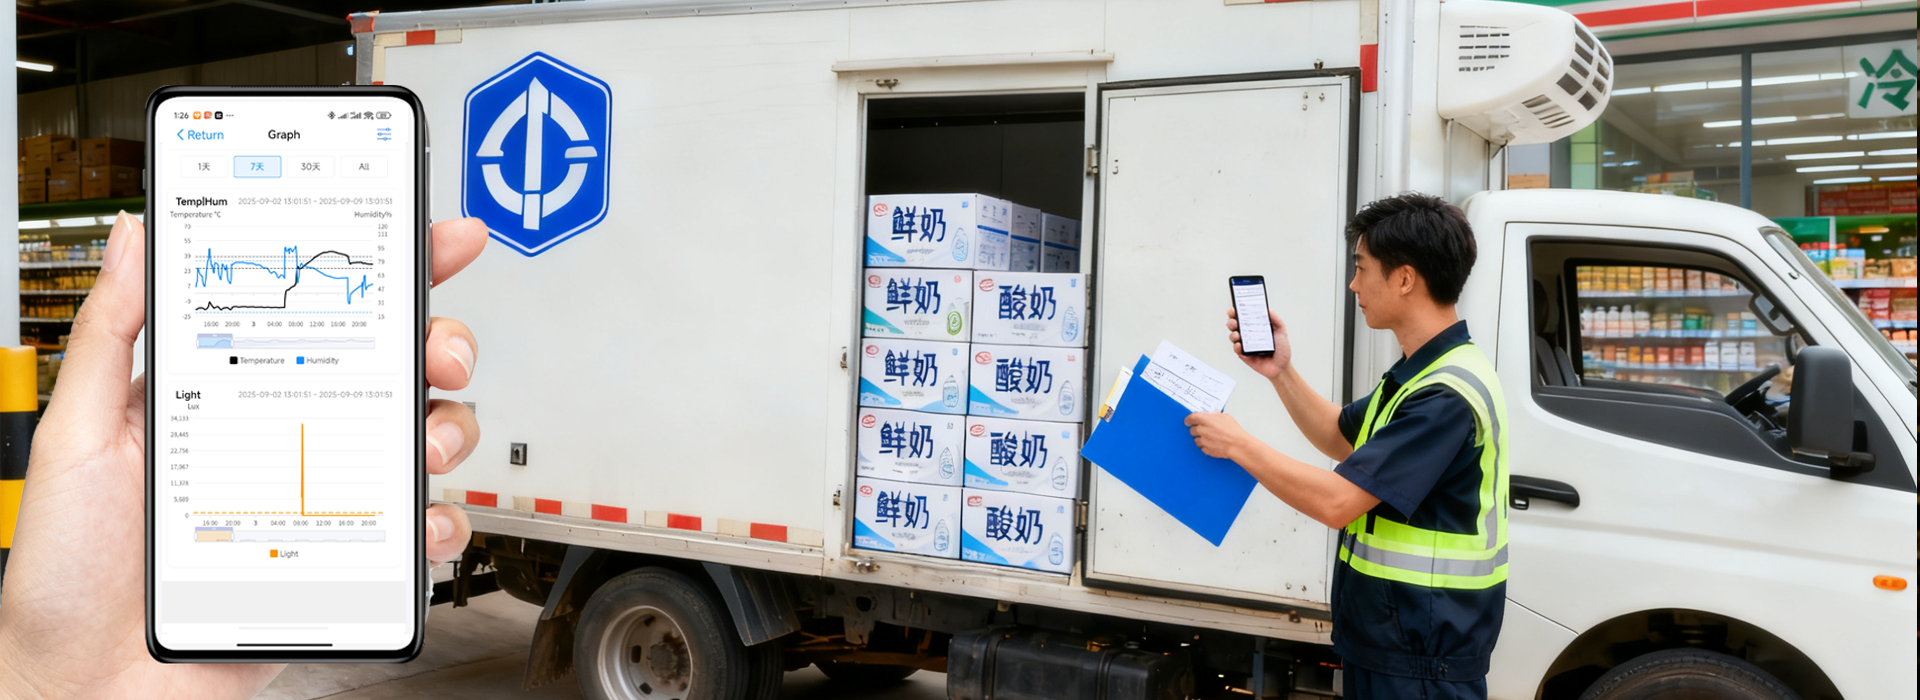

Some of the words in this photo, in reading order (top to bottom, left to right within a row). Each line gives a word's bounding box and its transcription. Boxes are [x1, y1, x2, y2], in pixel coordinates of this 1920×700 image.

[1858, 51, 1917, 110] 冷
[173, 111, 190, 120] 1:26
[188, 130, 224, 140] Return
[268, 129, 300, 142] Graph
[197, 162, 211, 172] 1天
[251, 162, 264, 171] 7天
[300, 162, 321, 172] 30天
[358, 162, 370, 171] All
[176, 196, 227, 208] Temp|Hum
[237, 197, 282, 205] 2025-09-02
[283, 197, 312, 205] 13:01:51
[318, 197, 364, 205] 2025-09-09
[365, 197, 393, 205] 13:01:51
[169, 210, 214, 220] Temperature
[353, 210, 393, 220] Humidity%
[892, 206, 946, 242] 鲜奶
[887, 278, 940, 314] 鲜奶
[999, 285, 1056, 320] 酸奶
[203, 320, 220, 328] 16:00
[224, 320, 241, 328] 20:00
[266, 320, 283, 328] 04:00
[288, 320, 304, 328] 08:00
[309, 320, 325, 328] 12:00
[330, 320, 347, 328] 16:00
[351, 320, 368, 328] 20:00
[239, 356, 286, 366] Temperature
[305, 356, 340, 366] Humidity
[884, 350, 937, 387] 鲜奶
[996, 358, 1052, 393] 酸奶
[176, 390, 201, 401] Light
[237, 390, 282, 399] 2025-09-02
[283, 390, 312, 399] 13:01:51
[318, 390, 364, 399] 2025-09-09
[364, 390, 393, 399] 13:01:51
[187, 402, 200, 411] Lux
[879, 422, 933, 458] 鲜奶
[991, 432, 1047, 468] 酸奶
[876, 491, 929, 529] 鲜奶
[202, 519, 219, 527] 16:00
[225, 519, 242, 527] 20:00
[270, 519, 286, 527] 04:00
[292, 519, 309, 527] 08:00
[316, 519, 332, 527] 12:00
[338, 519, 355, 527] 16:00
[360, 519, 377, 527] 20:00
[986, 505, 1043, 545] 酸奶
[279, 550, 299, 560] Light
